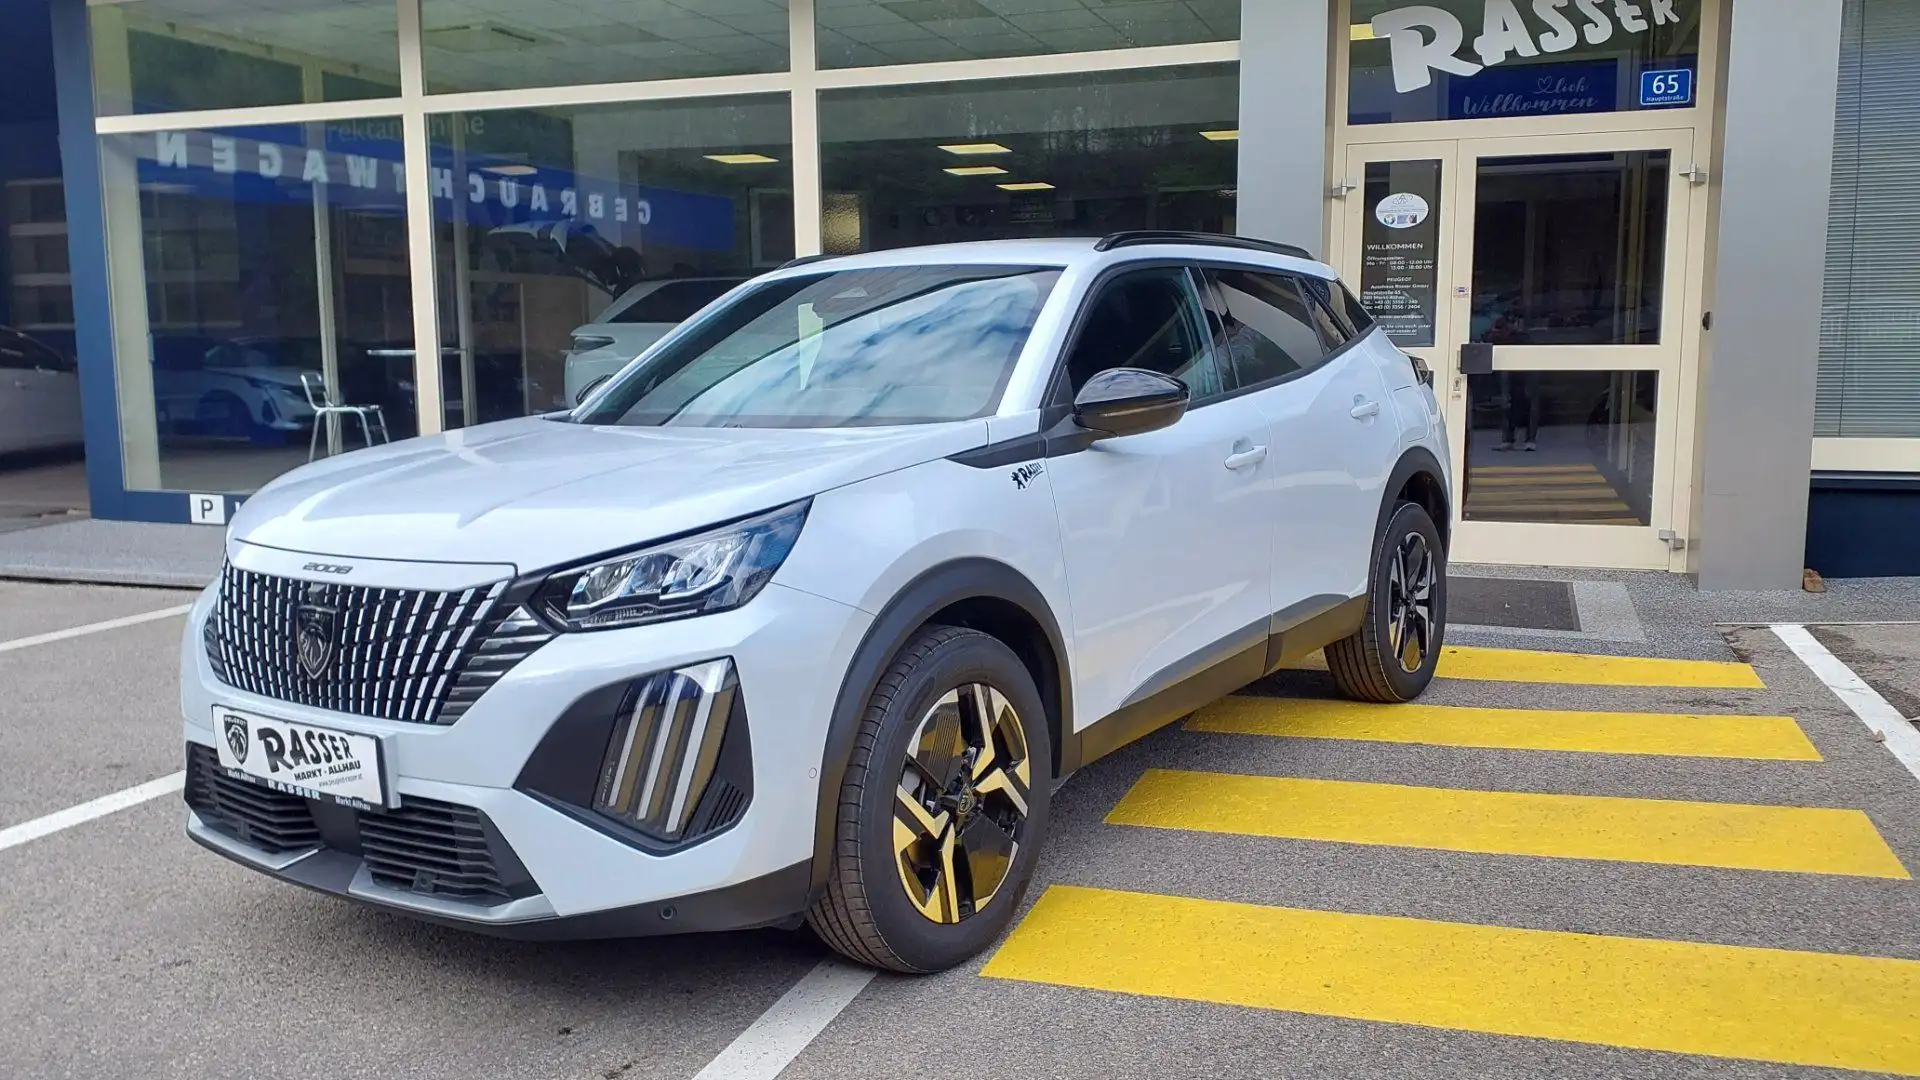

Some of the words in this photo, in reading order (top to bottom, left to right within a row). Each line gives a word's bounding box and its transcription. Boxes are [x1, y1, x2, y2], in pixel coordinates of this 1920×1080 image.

[1371, 0, 1680, 94] RASSER
[1652, 74, 1679, 95] 65
[200, 498, 213, 519] P
[302, 562, 353, 575] 2008
[256, 727, 354, 774] RASSER
[328, 760, 362, 775] ALLHAU
[267, 778, 322, 801] RASSER
